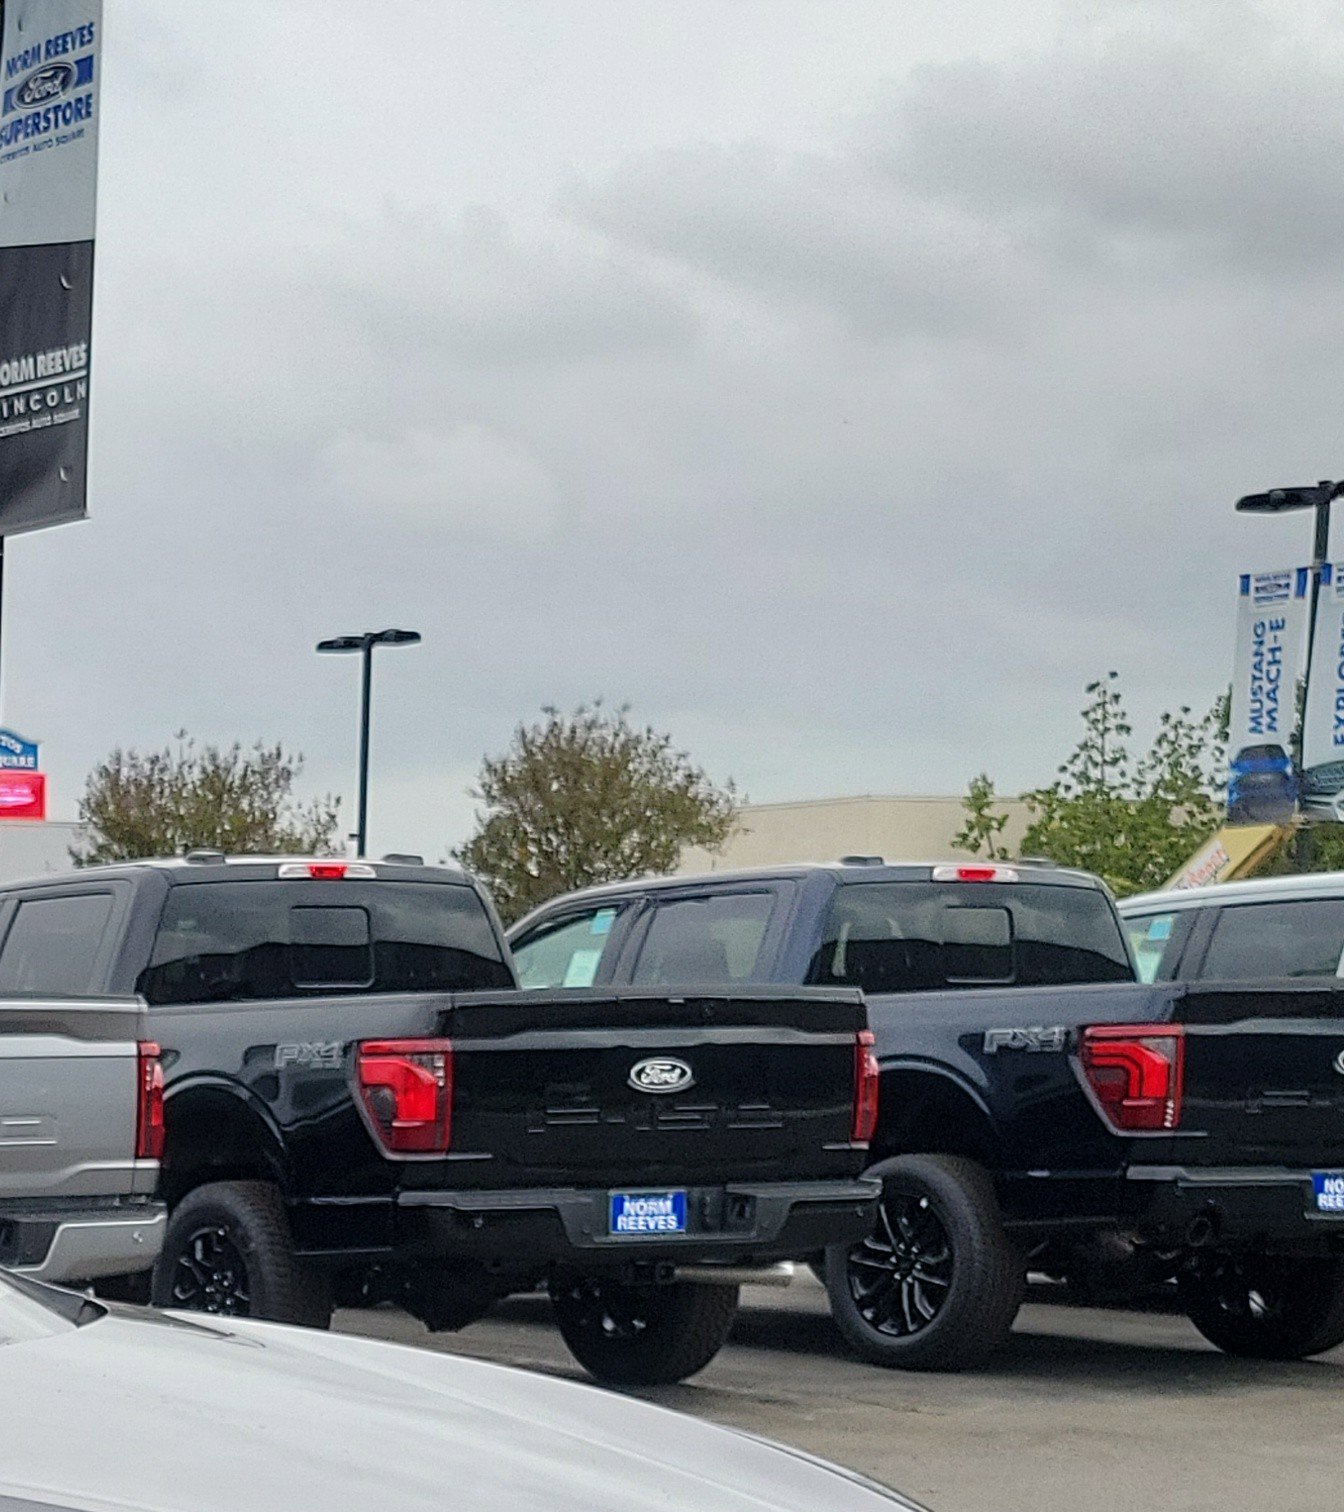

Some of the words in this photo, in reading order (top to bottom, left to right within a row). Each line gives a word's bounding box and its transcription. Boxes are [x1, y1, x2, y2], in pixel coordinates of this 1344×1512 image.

[5, 42, 41, 80] NORM
[43, 22, 94, 61] REEVES
[36, 343, 87, 378] REEVES
[1249, 619, 1266, 734] MUSTANG
[1266, 617, 1286, 732] MACH-E
[983, 1026, 1066, 1054] FX4
[274, 1041, 345, 1069] FX4
[640, 1063, 683, 1085] Ford
[1324, 1178, 1344, 1195] NO
[622, 1199, 673, 1216] NORM
[617, 1214, 678, 1231] REEVES
